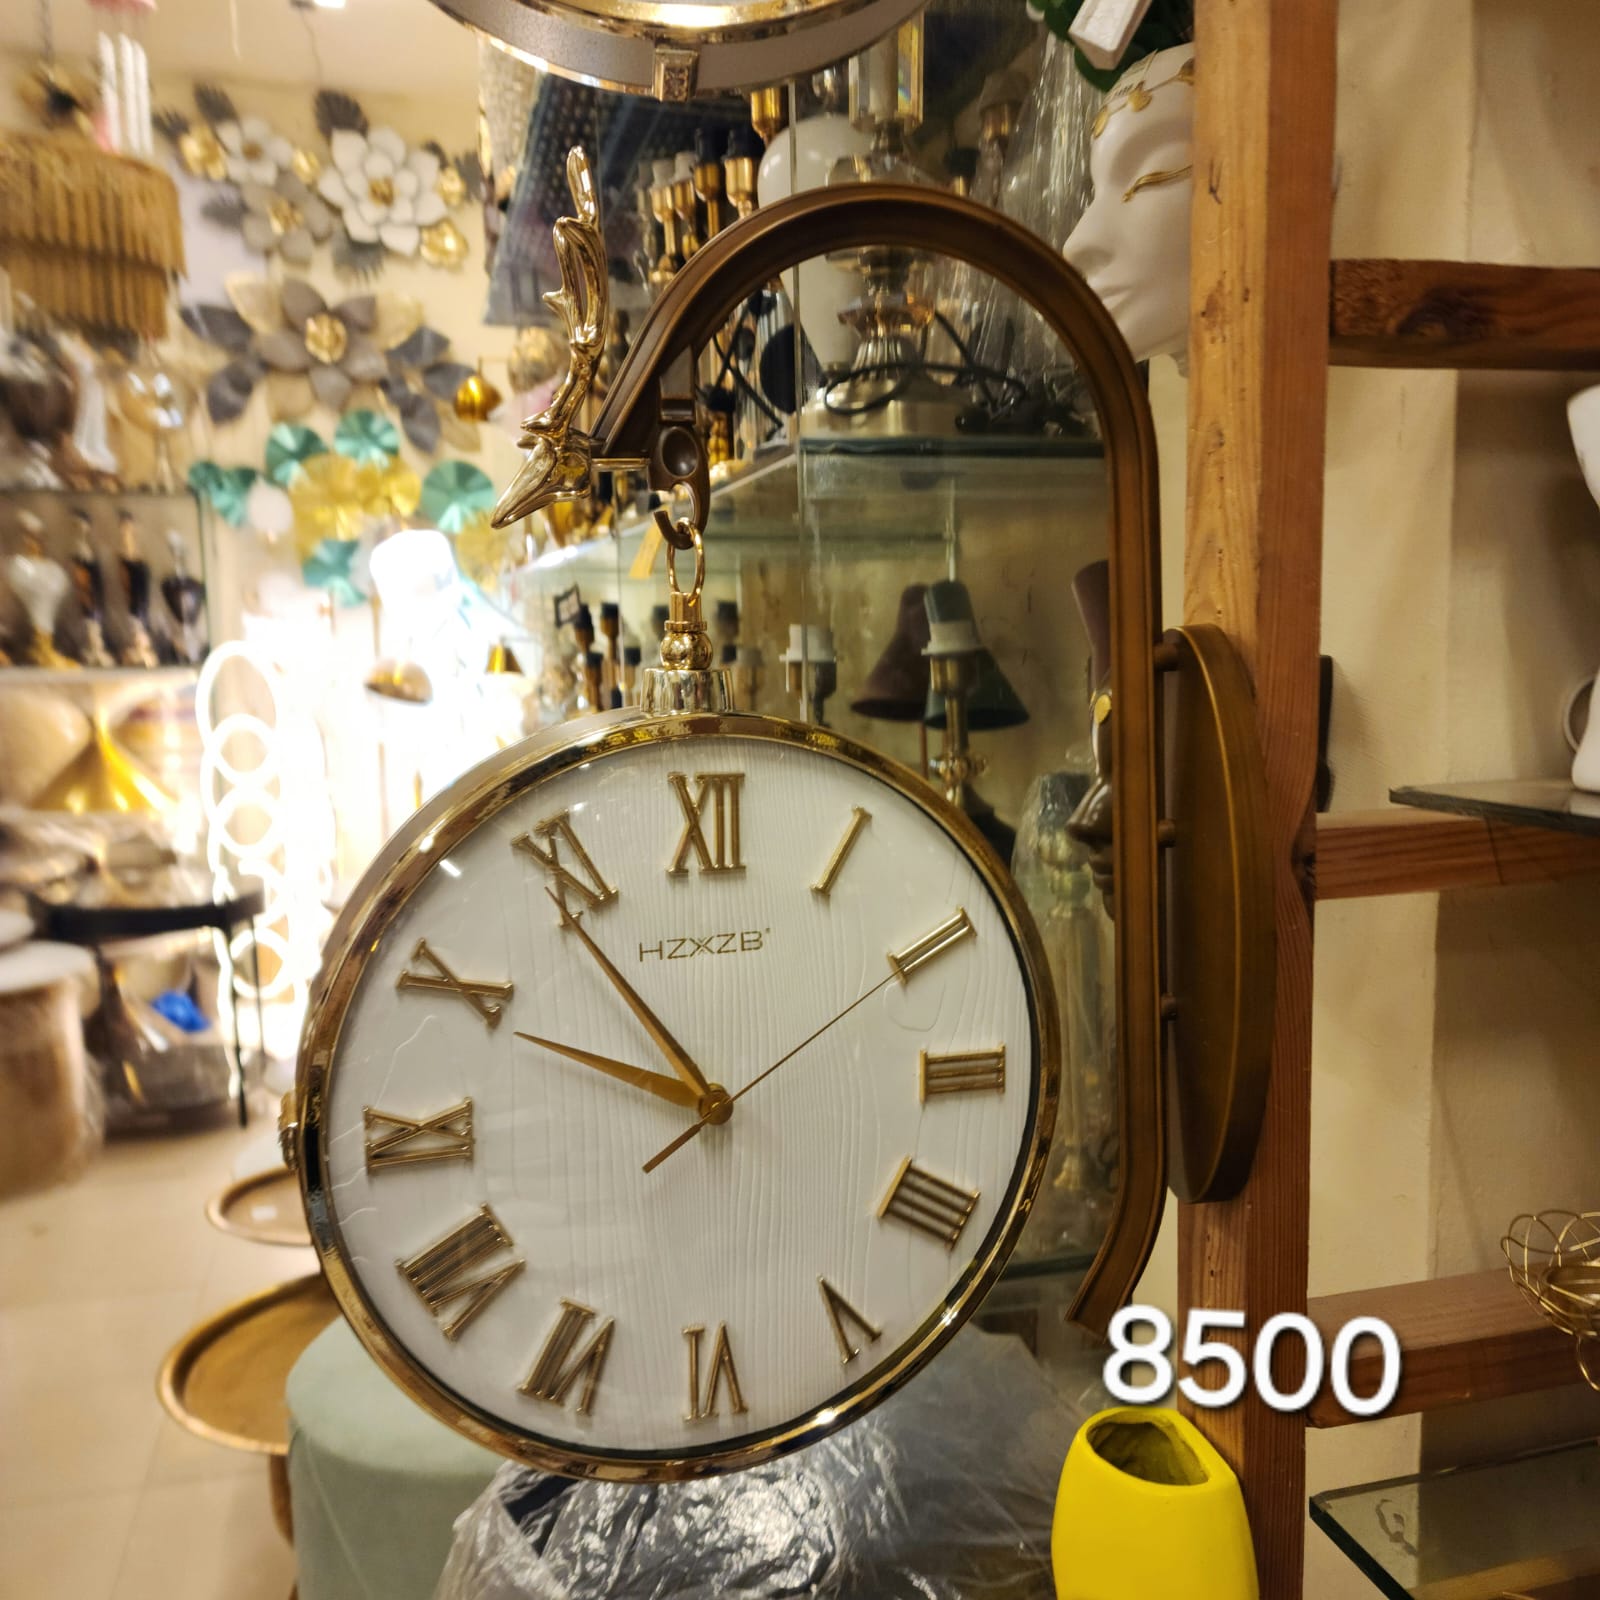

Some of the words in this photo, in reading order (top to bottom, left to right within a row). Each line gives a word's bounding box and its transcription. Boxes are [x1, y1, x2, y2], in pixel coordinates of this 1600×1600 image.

[511, 809, 619, 928] XI
[666, 773, 746, 876] XII
[396, 938, 514, 1027] X
[888, 907, 977, 982] II
[919, 1045, 1006, 1104] III
[363, 1098, 475, 1173] IX
[396, 1203, 525, 1341] VIII
[518, 1299, 615, 1417] VII
[817, 1276, 882, 1364] V
[682, 1323, 748, 1421] VI
